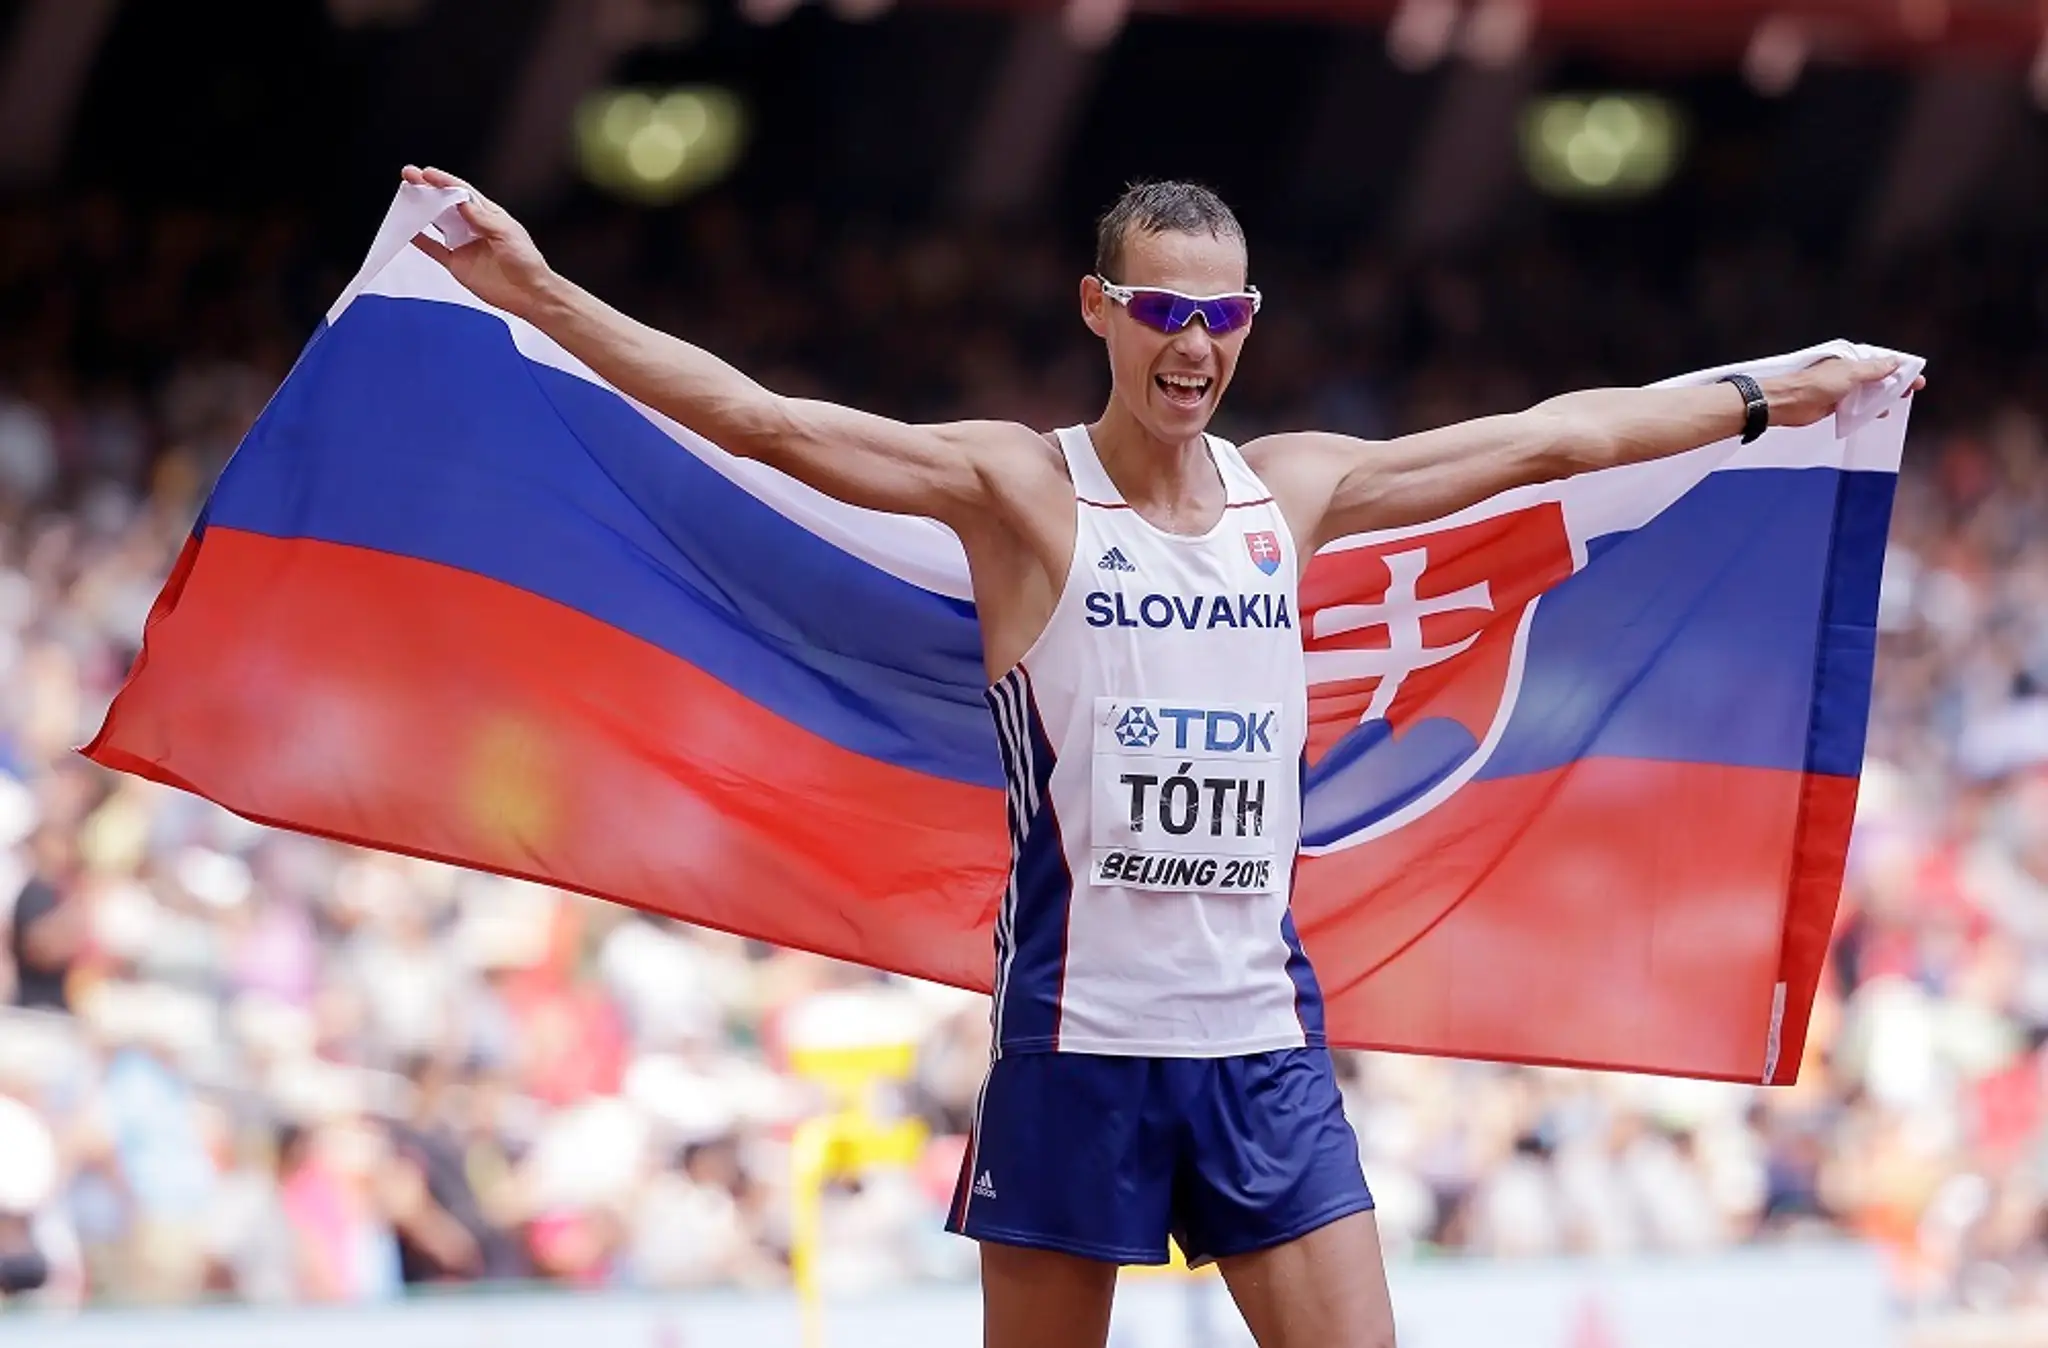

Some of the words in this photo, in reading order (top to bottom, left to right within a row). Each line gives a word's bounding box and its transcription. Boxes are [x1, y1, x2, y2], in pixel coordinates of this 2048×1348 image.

[1085, 591, 1292, 630] SLOVAKIA
[1159, 708, 1272, 752] TDK
[1120, 762, 1265, 837] TÓTH
[1100, 852, 1218, 886] BEIJING
[1219, 860, 1271, 888] 2015
